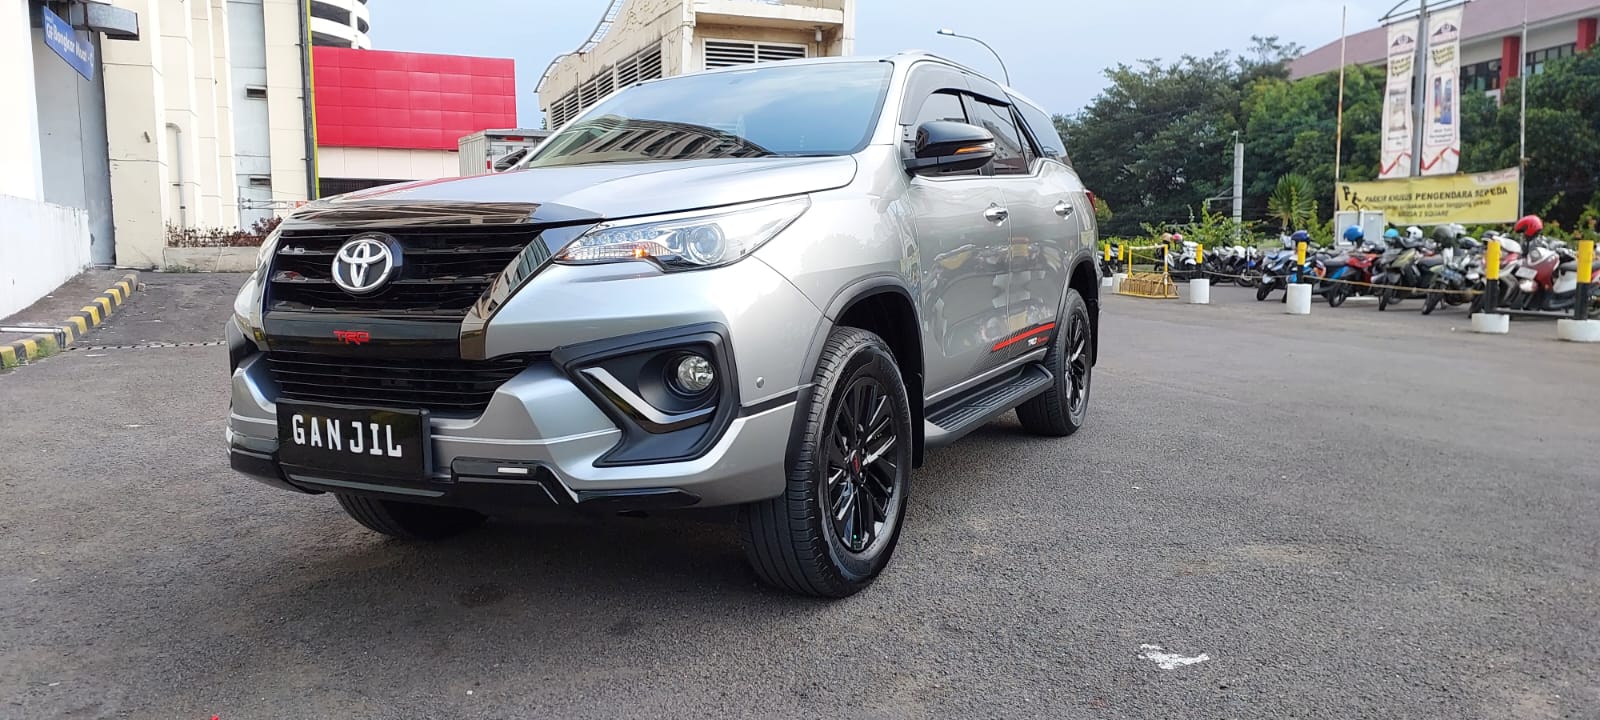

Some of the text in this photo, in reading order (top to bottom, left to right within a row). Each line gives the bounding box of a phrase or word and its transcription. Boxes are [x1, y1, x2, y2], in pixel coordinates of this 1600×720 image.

[1365, 186, 1508, 202] PARKIR KHUSUS PENGENDARA SEPEDA
[333, 331, 369, 344] TRD
[292, 414, 402, 457] GANJIL
